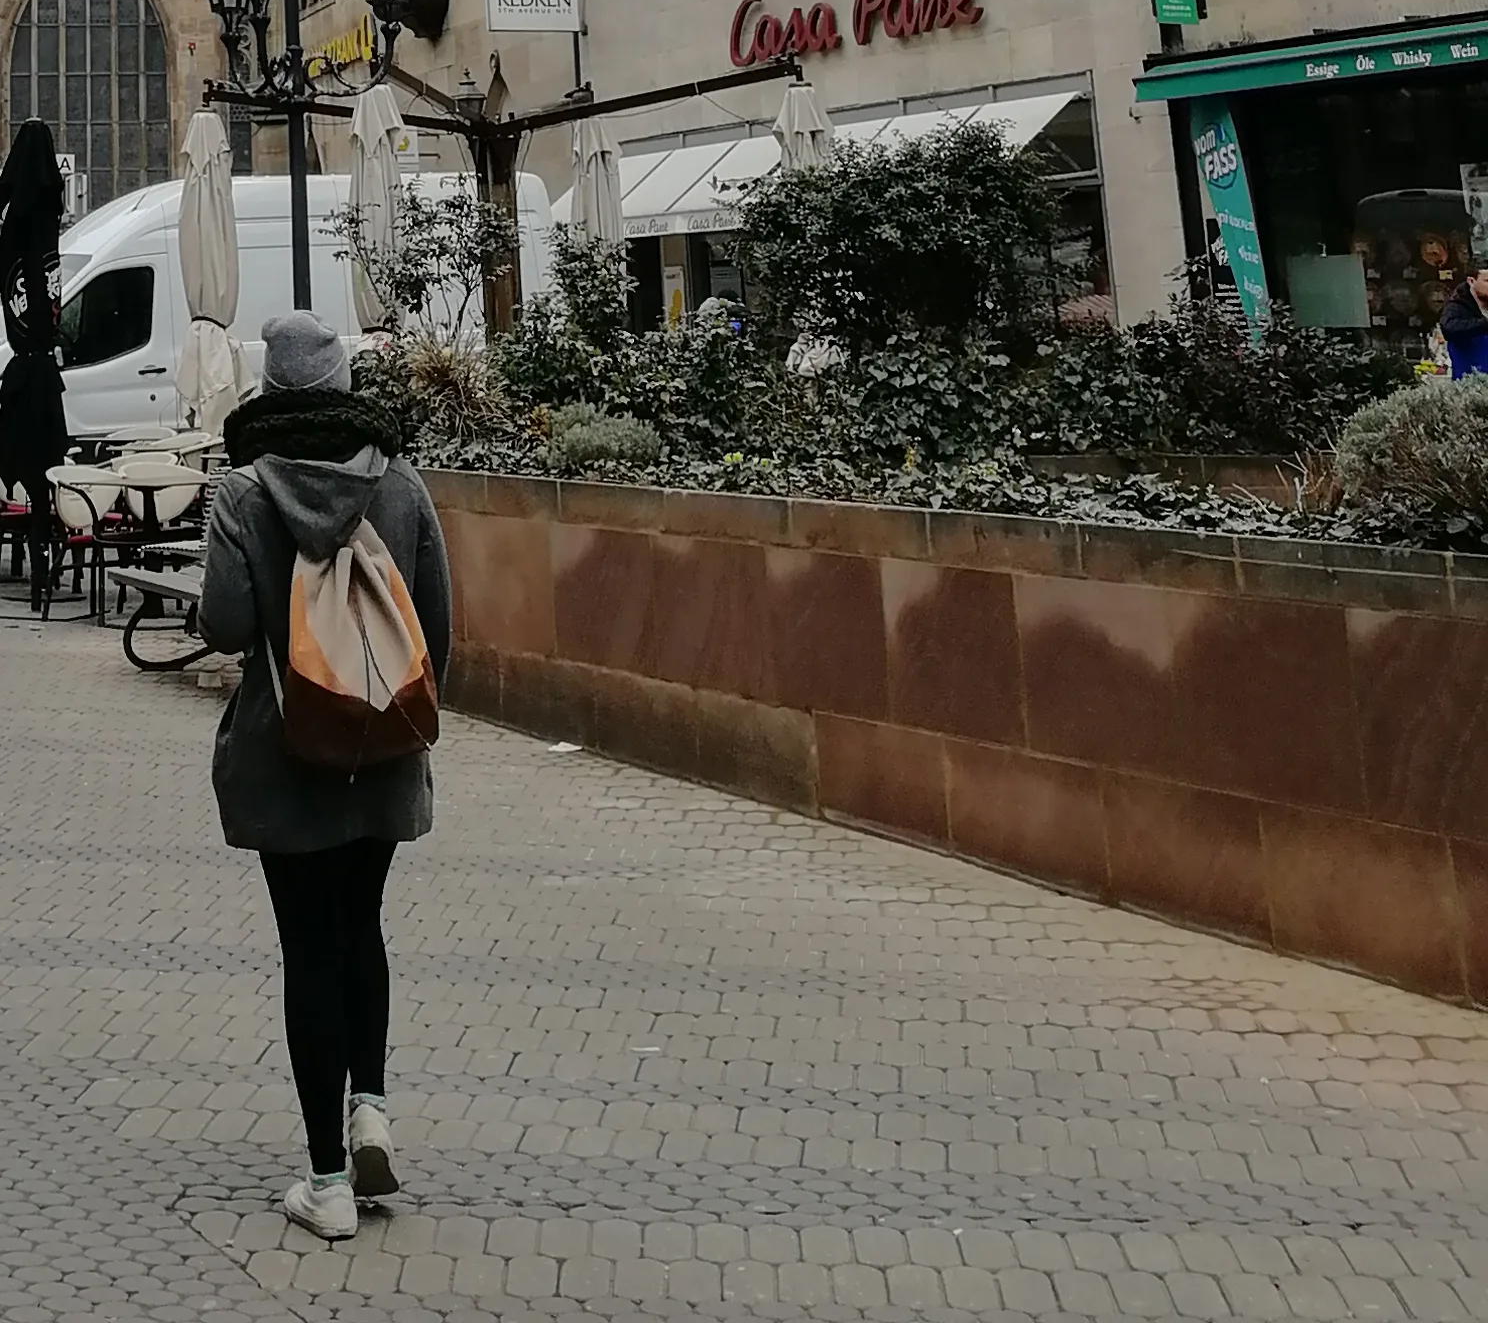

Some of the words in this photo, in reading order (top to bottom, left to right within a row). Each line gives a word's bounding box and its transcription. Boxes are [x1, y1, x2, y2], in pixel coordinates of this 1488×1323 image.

[518, 7, 551, 15] AVENUE
[555, 7, 573, 15] NYC
[1305, 61, 1340, 79] Essige
[1392, 49, 1432, 67] Whisky
[1450, 42, 1479, 59] Wein
[1194, 130, 1216, 156] vom
[1204, 143, 1237, 181] FASS
[624, 221, 646, 236] Casa
[687, 215, 710, 231] Casa
